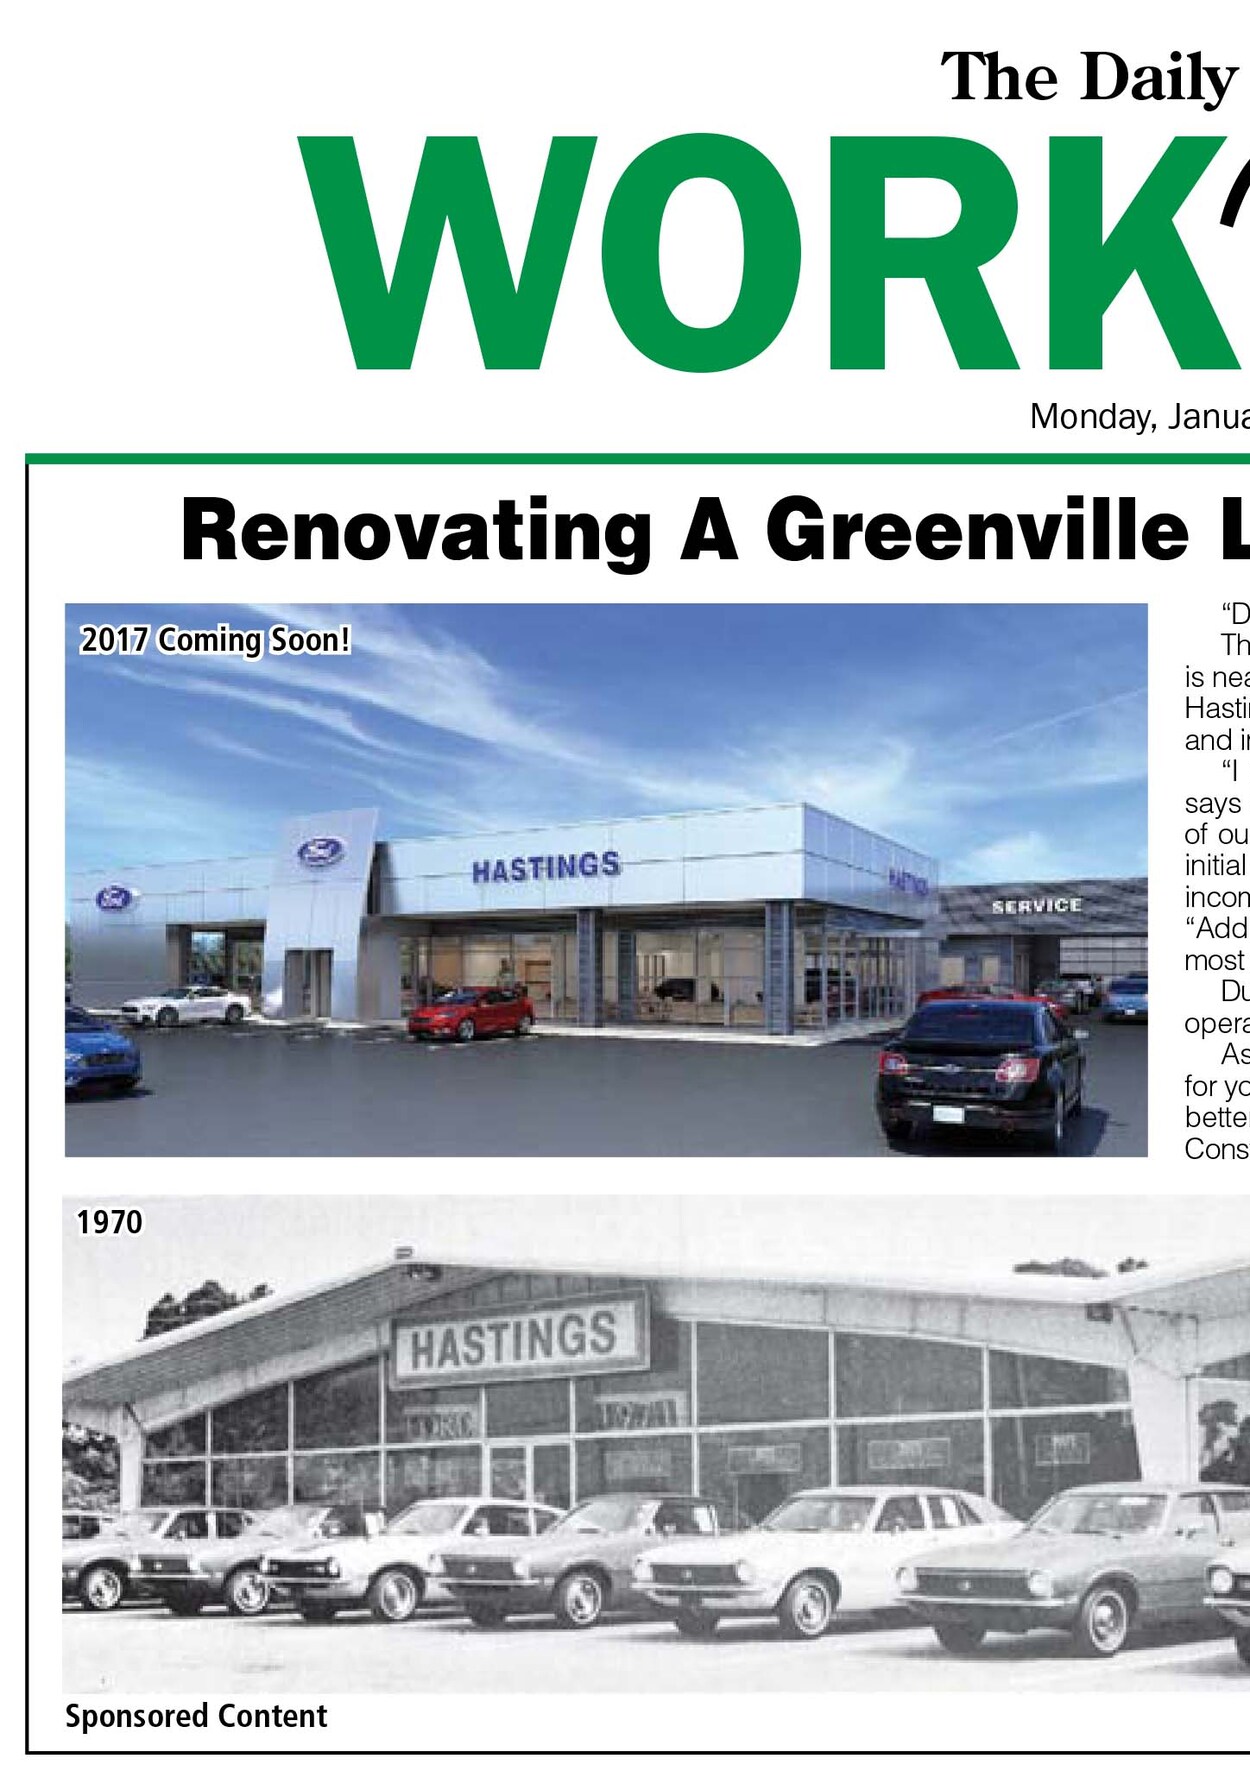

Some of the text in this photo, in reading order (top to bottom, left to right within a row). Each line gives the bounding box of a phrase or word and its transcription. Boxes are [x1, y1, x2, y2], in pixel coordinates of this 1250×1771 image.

[940, 50, 1058, 101] The
[1079, 50, 1241, 112] Daily
[1031, 402, 1157, 436] Monday,
[183, 494, 651, 577] Renovating
[679, 496, 739, 560] A
[766, 494, 1189, 562] Greenville
[1222, 758, 1237, 782] “I
[472, 850, 622, 884] HASTINGS
[1185, 852, 1246, 876] initial
[992, 897, 1083, 915] SERVICE
[1185, 949, 1246, 971] most
[1184, 1073, 1218, 1097] for
[411, 1309, 617, 1370] HASTINGS
[65, 1701, 328, 1735] Sponsored Content
